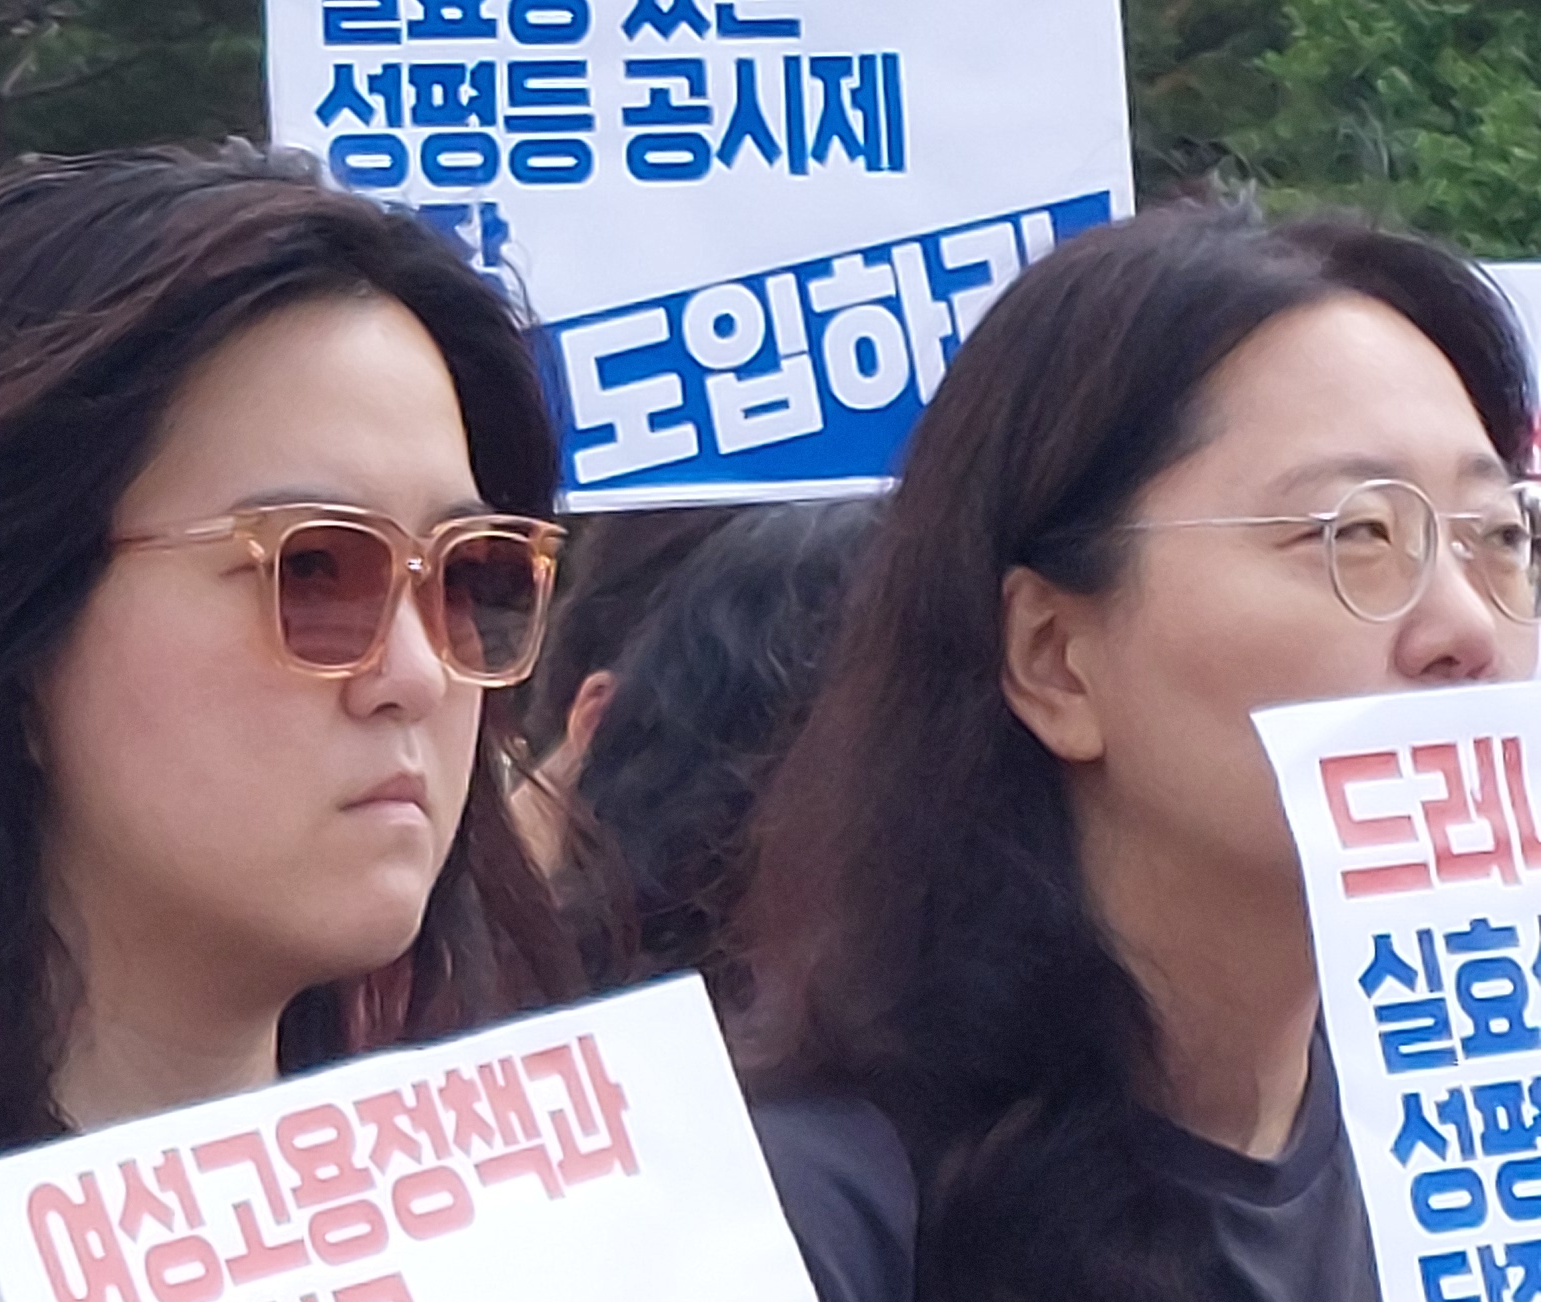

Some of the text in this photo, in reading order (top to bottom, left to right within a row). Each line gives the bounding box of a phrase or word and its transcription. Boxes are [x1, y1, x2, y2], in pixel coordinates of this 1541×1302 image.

[314, 51, 907, 188] 성평등 공시제
[1357, 916, 1541, 1074] 실효
